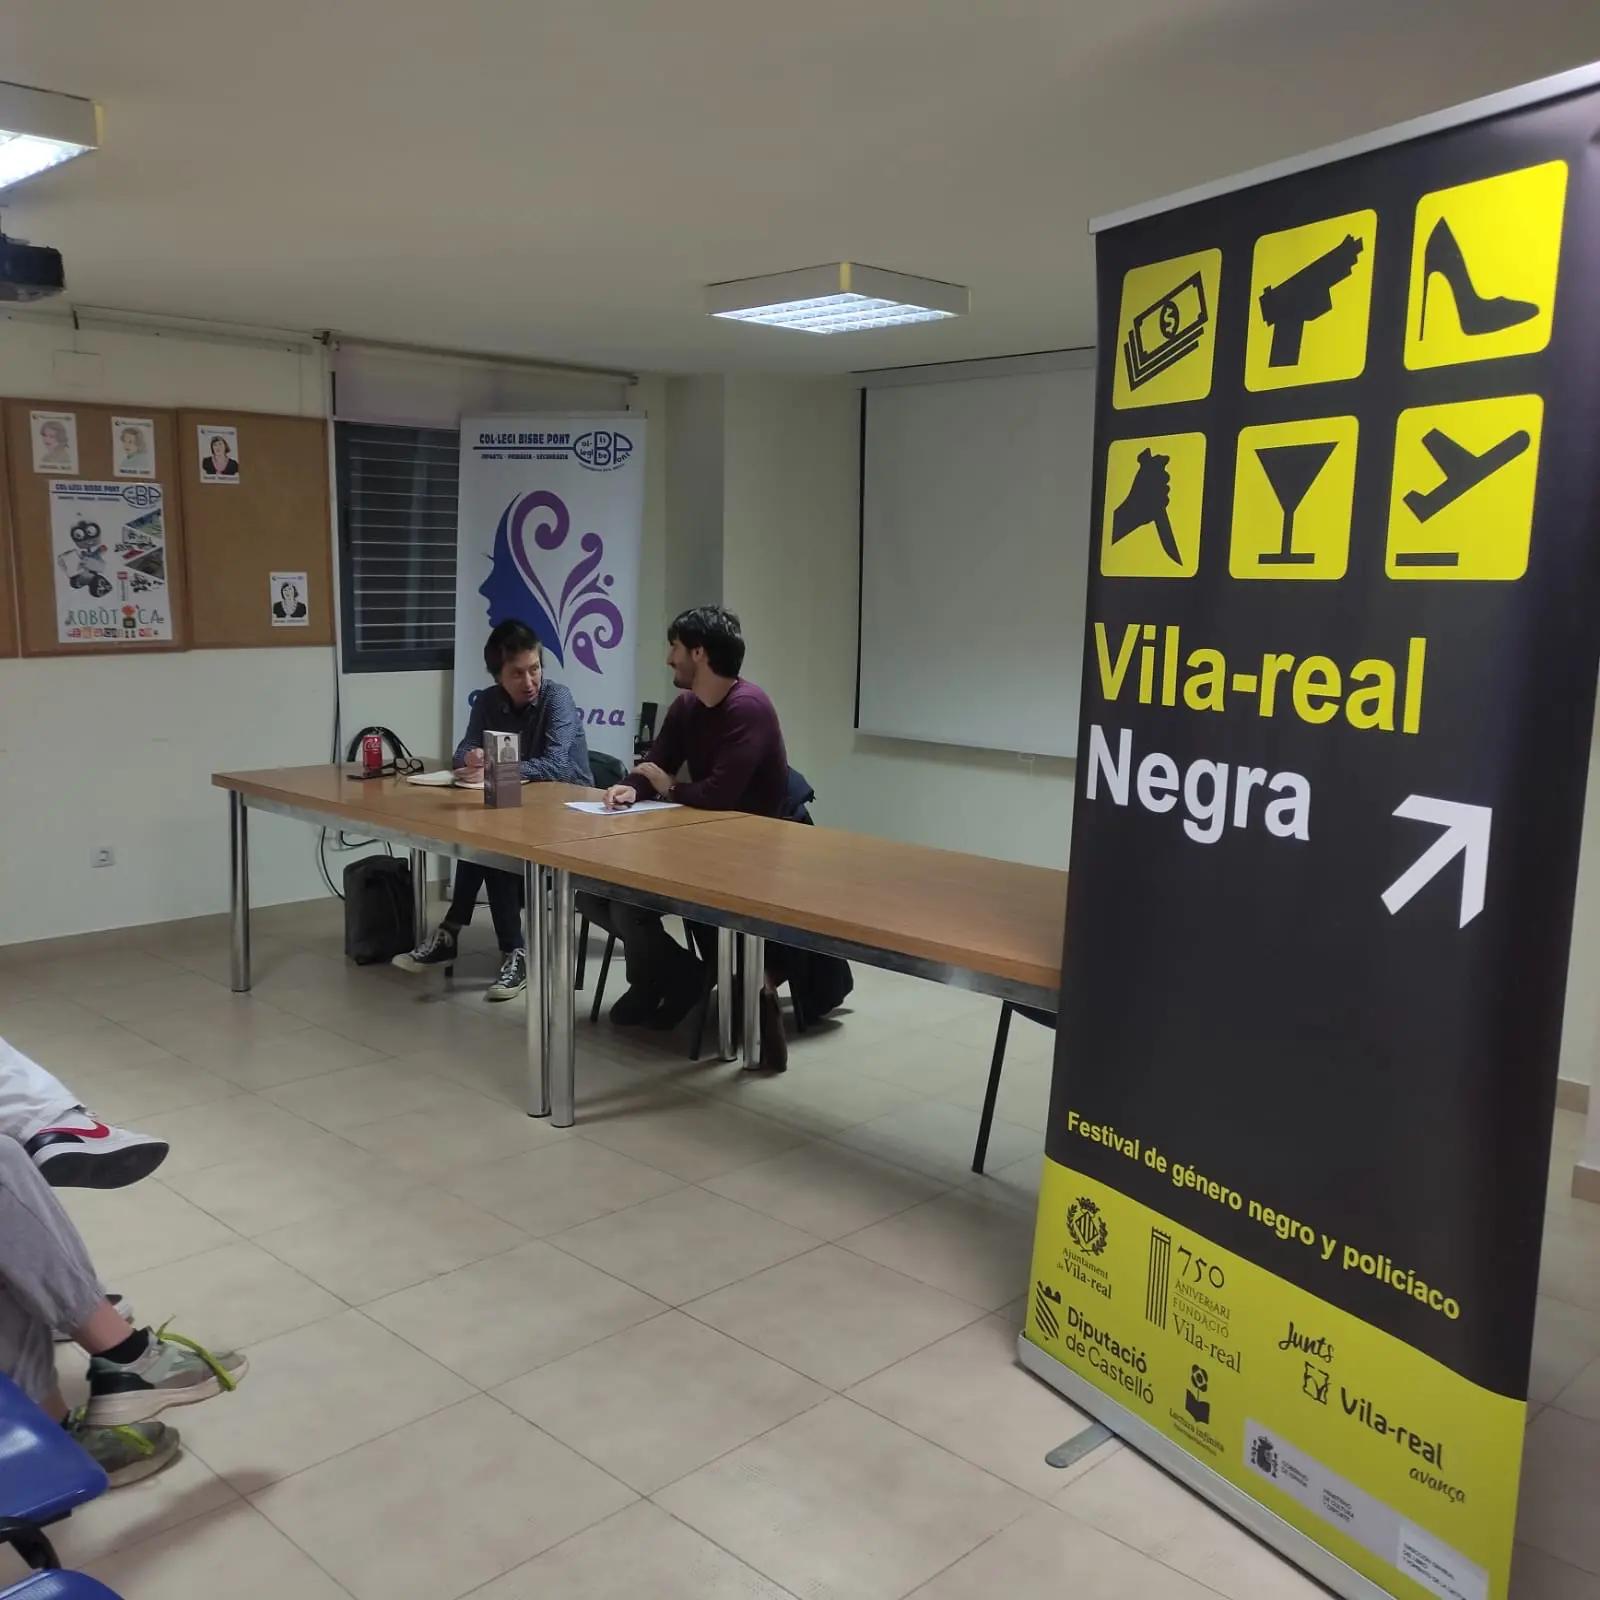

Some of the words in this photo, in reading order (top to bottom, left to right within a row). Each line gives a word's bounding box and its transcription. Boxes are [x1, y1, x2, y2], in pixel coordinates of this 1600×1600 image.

[518, 433, 544, 444] BISBE
[547, 433, 570, 444] PONT
[1094, 622, 1427, 734] Vila-real
[1086, 724, 1311, 844] Negra
[1068, 1111, 1140, 1161] Festival
[1144, 1146, 1168, 1174] de
[1171, 1163, 1242, 1212] género
[1249, 1200, 1315, 1246] negro
[1320, 1236, 1337, 1261] y
[1343, 1244, 1460, 1321] policíaco
[1062, 1248, 1109, 1280] Ajuntament
[1064, 1258, 1112, 1300] Vila-real
[1177, 1245, 1225, 1289] 750
[1172, 1297, 1230, 1339] FUNDACIÓ
[1174, 1280, 1231, 1321] ANIVERSARI
[1067, 1305, 1148, 1374] Diputació
[1173, 1313, 1242, 1374] Vila-real
[1278, 1321, 1335, 1364] Junts
[1066, 1334, 1086, 1358] de
[1088, 1347, 1155, 1405] Castelló
[1340, 1386, 1444, 1471] Vila-real
[1409, 1467, 1467, 1504] avança
